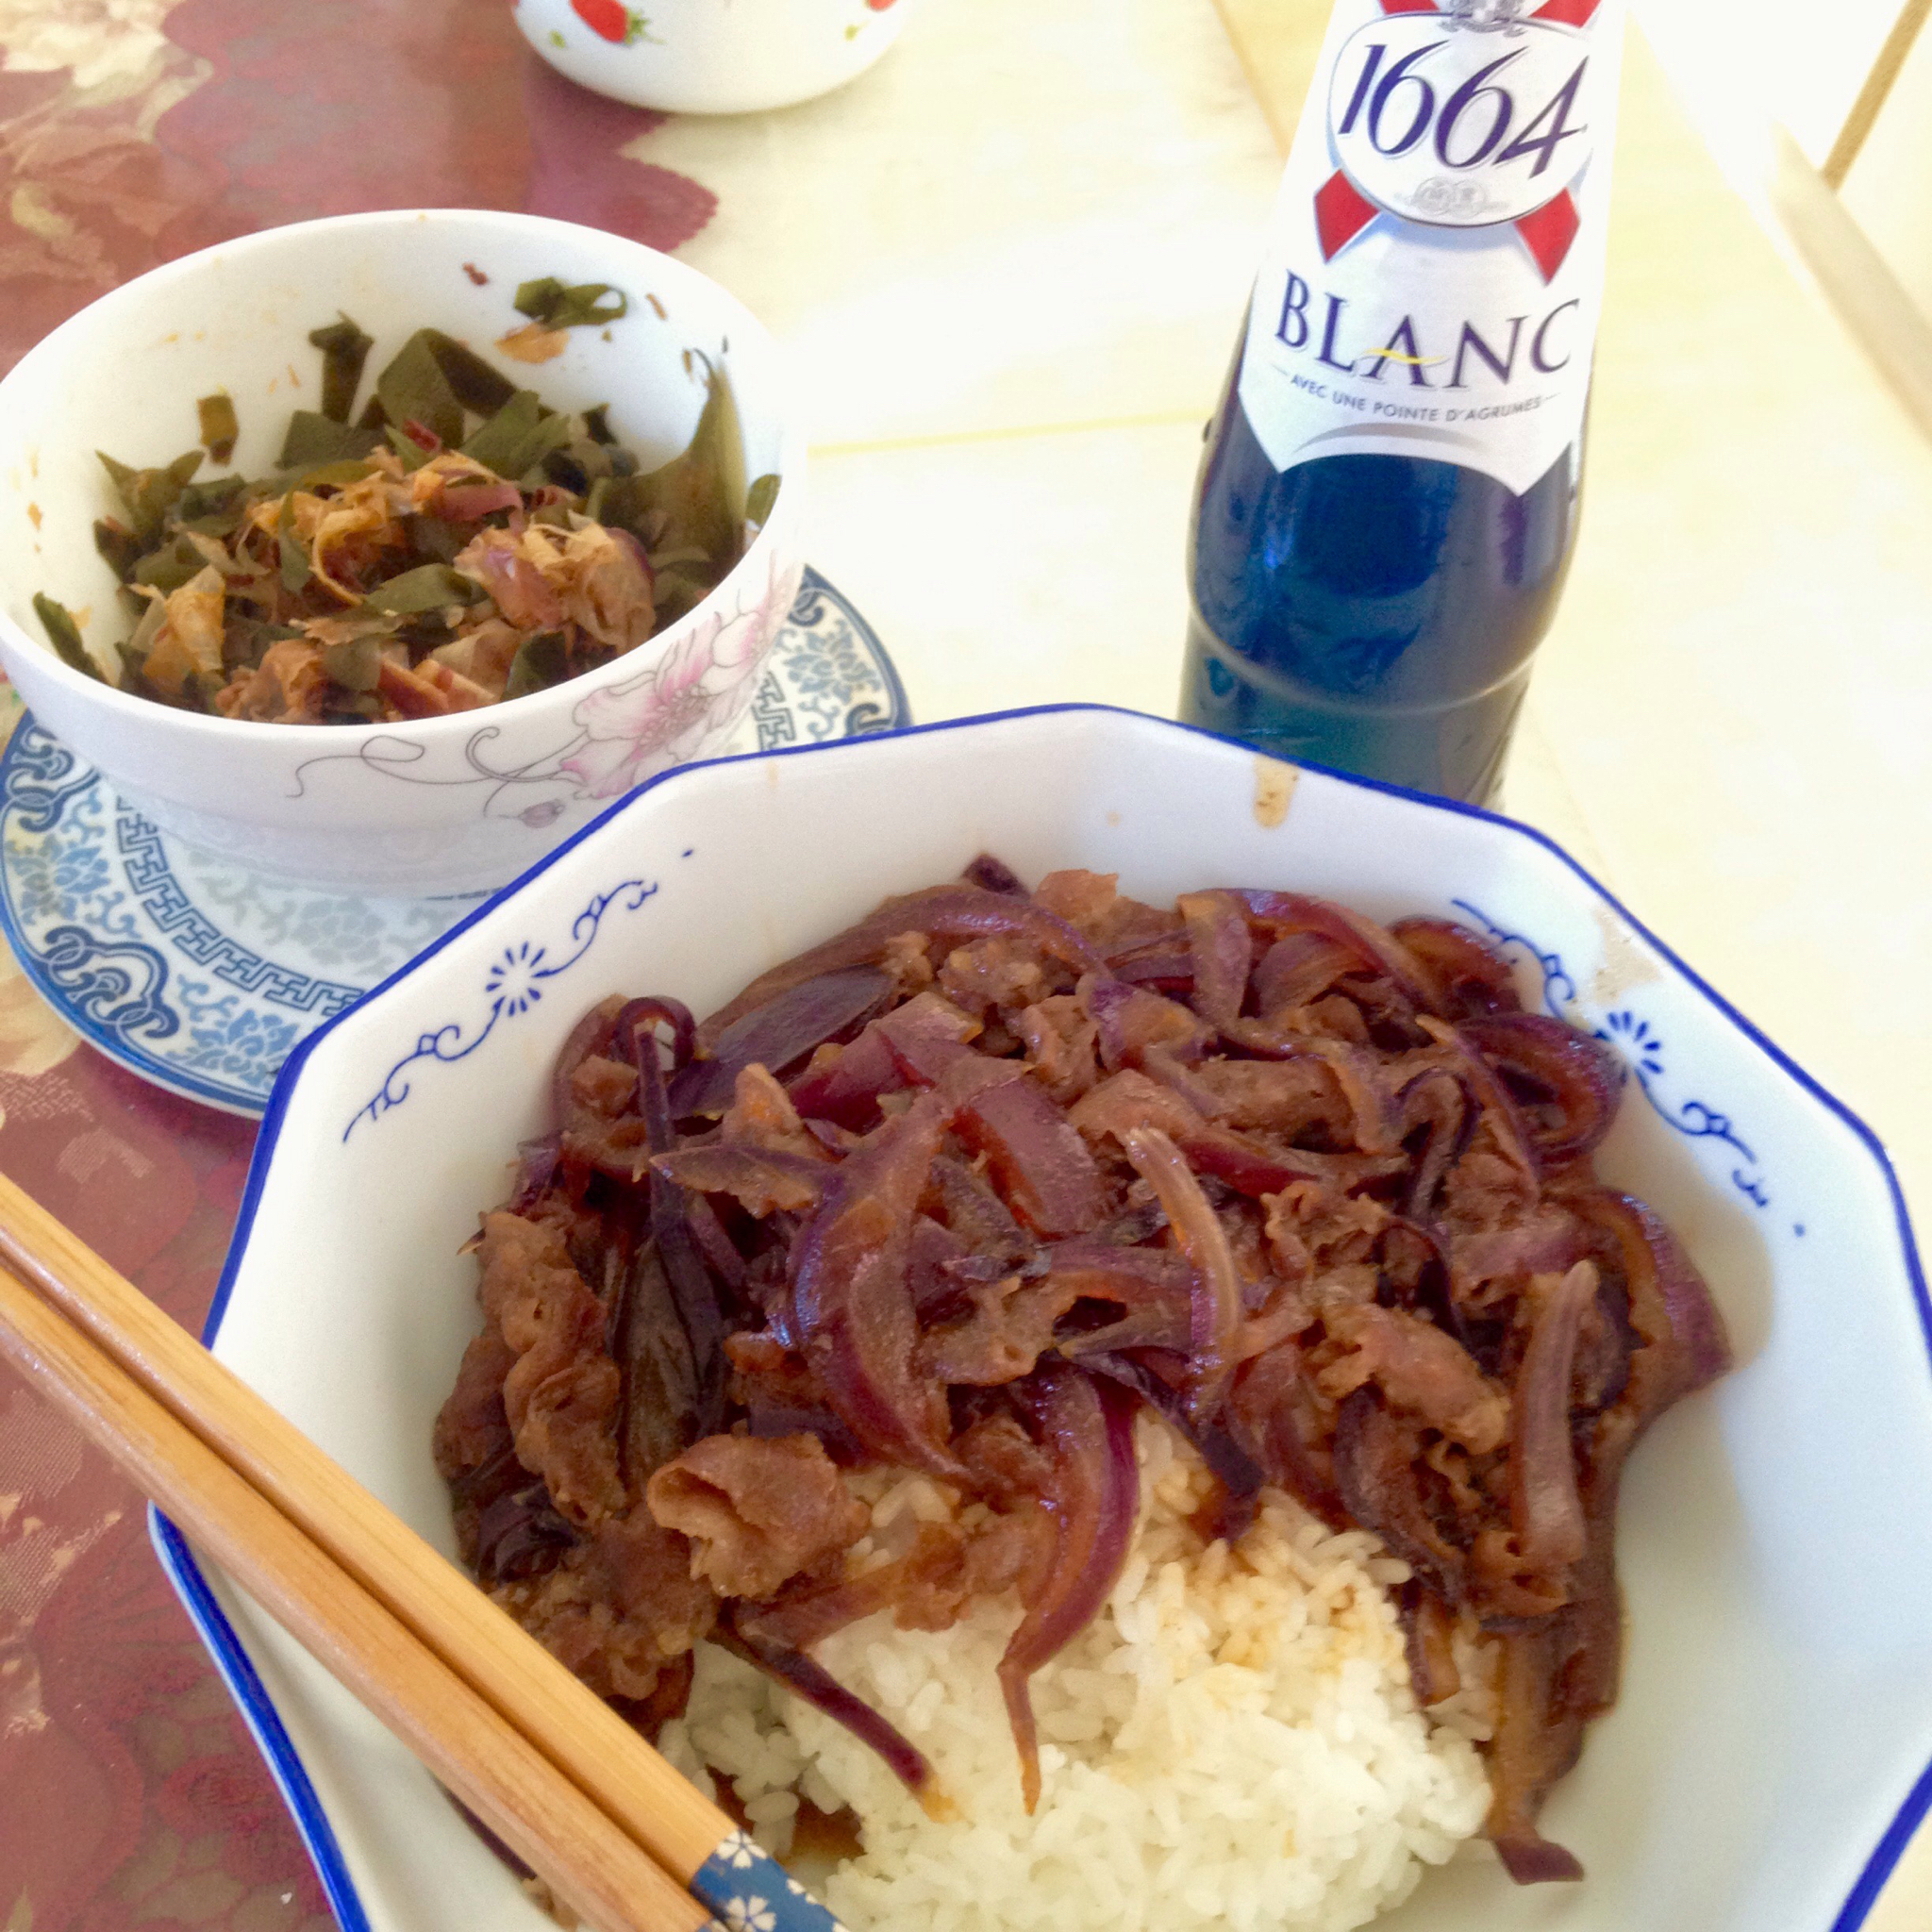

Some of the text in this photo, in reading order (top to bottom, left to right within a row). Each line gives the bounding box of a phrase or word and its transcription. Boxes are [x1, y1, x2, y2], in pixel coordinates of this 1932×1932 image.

[1338, 40, 1591, 179] 1664
[1274, 268, 1580, 390] BLANC
[1291, 374, 1542, 422] AVEC UNE POINTE D'AGRUMES
